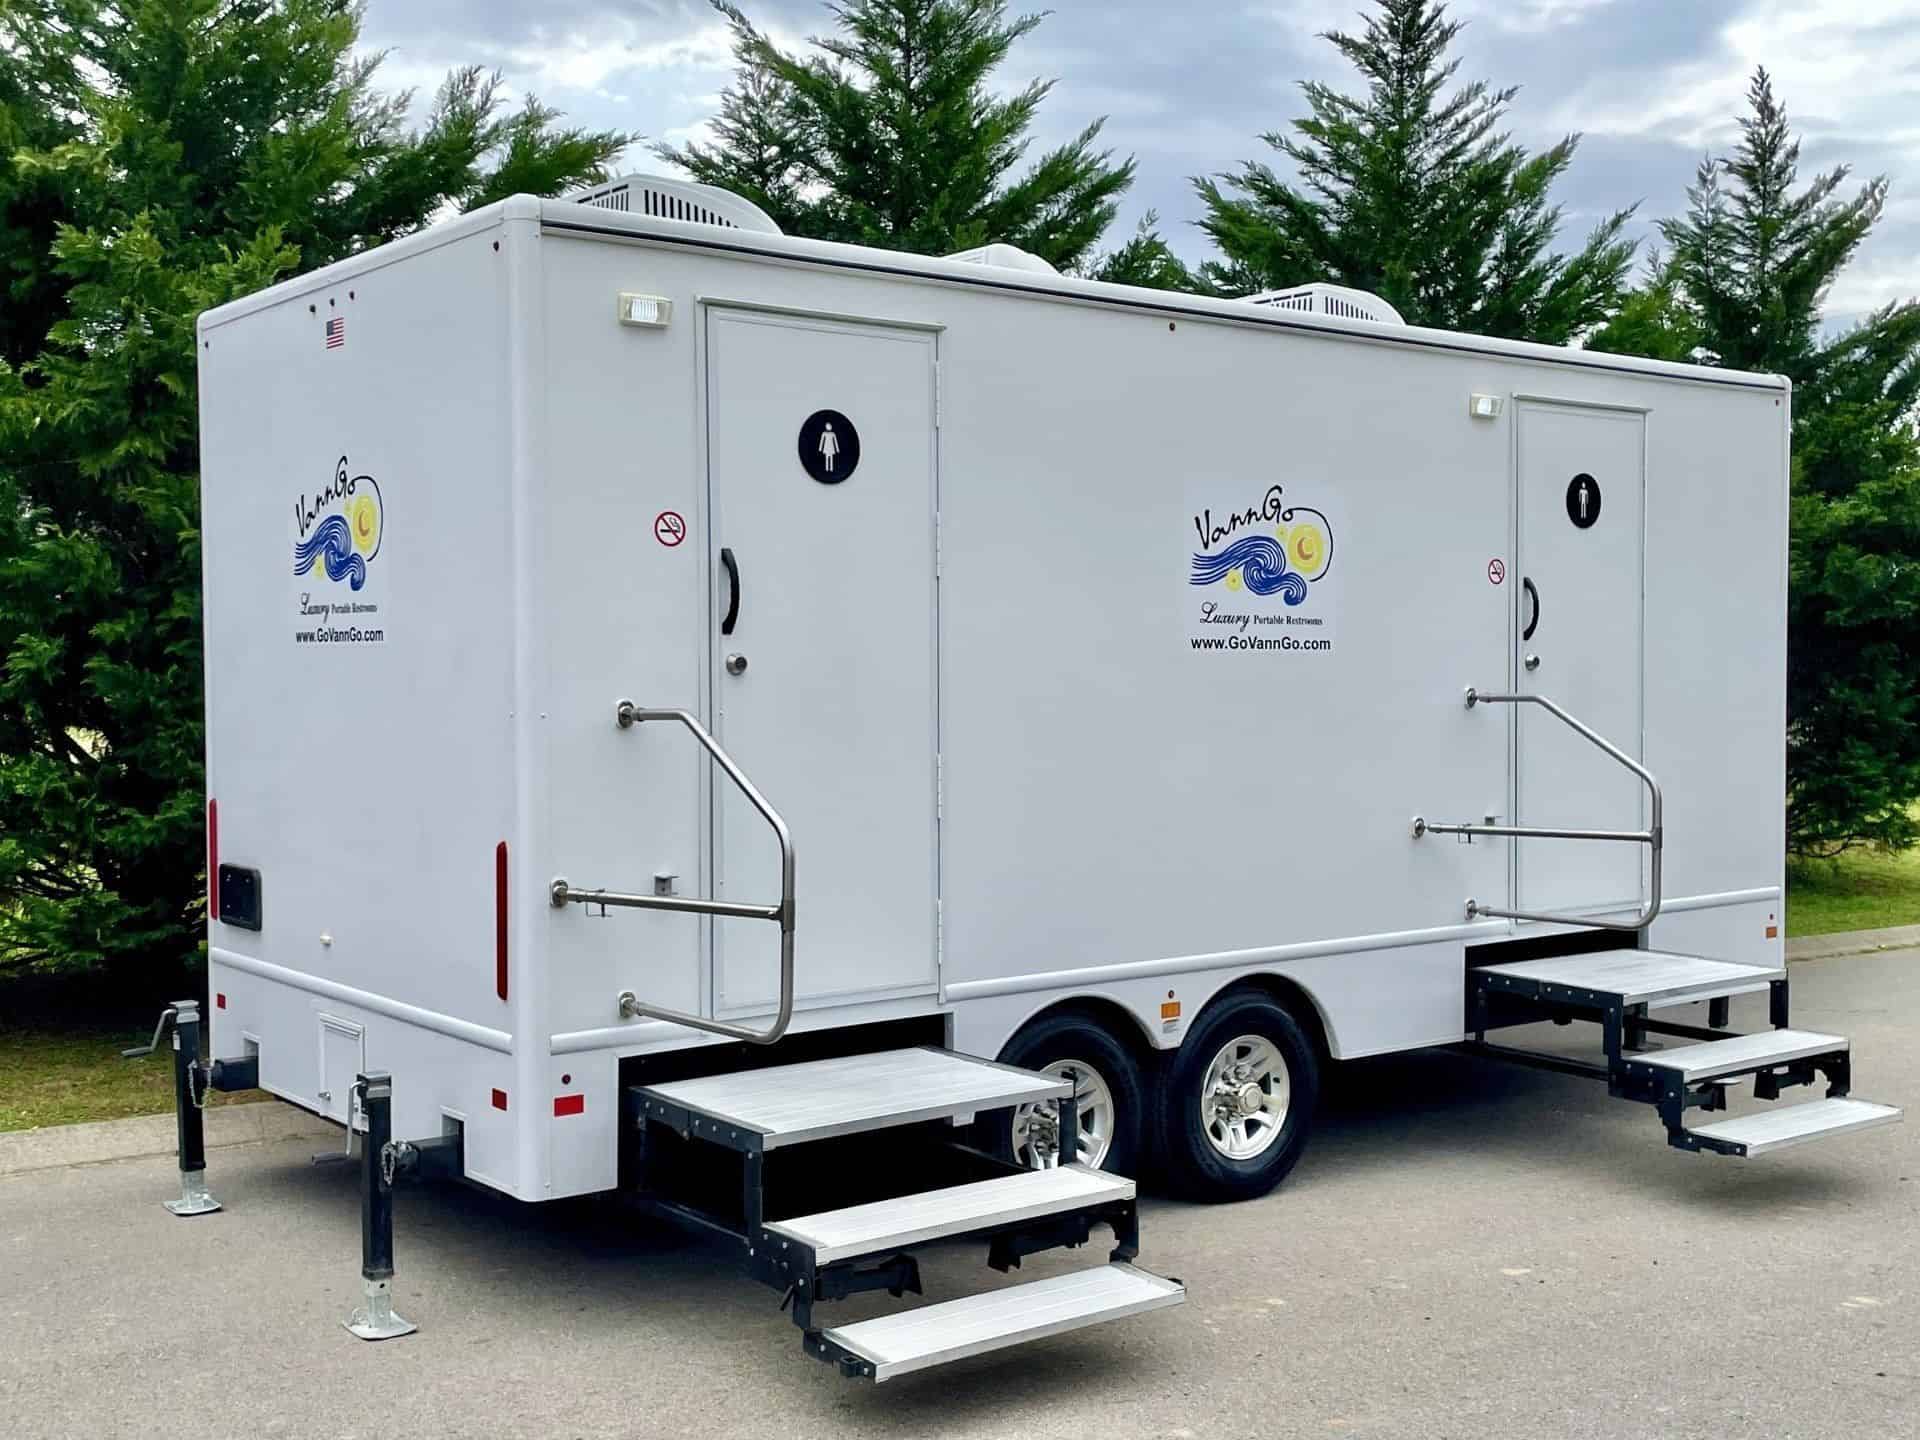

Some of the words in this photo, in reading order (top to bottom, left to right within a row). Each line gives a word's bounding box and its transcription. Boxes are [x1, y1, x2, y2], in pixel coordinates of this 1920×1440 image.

[296, 455, 356, 538] VannGo
[1195, 484, 1294, 550] VannGo
[1200, 601, 1250, 632] Luxury
[1253, 615, 1284, 625] Portable
[1286, 615, 1323, 626] Restrooms
[296, 627, 384, 643] www.GoVannGo.com
[1191, 635, 1331, 651] www.GoVannGo.com
